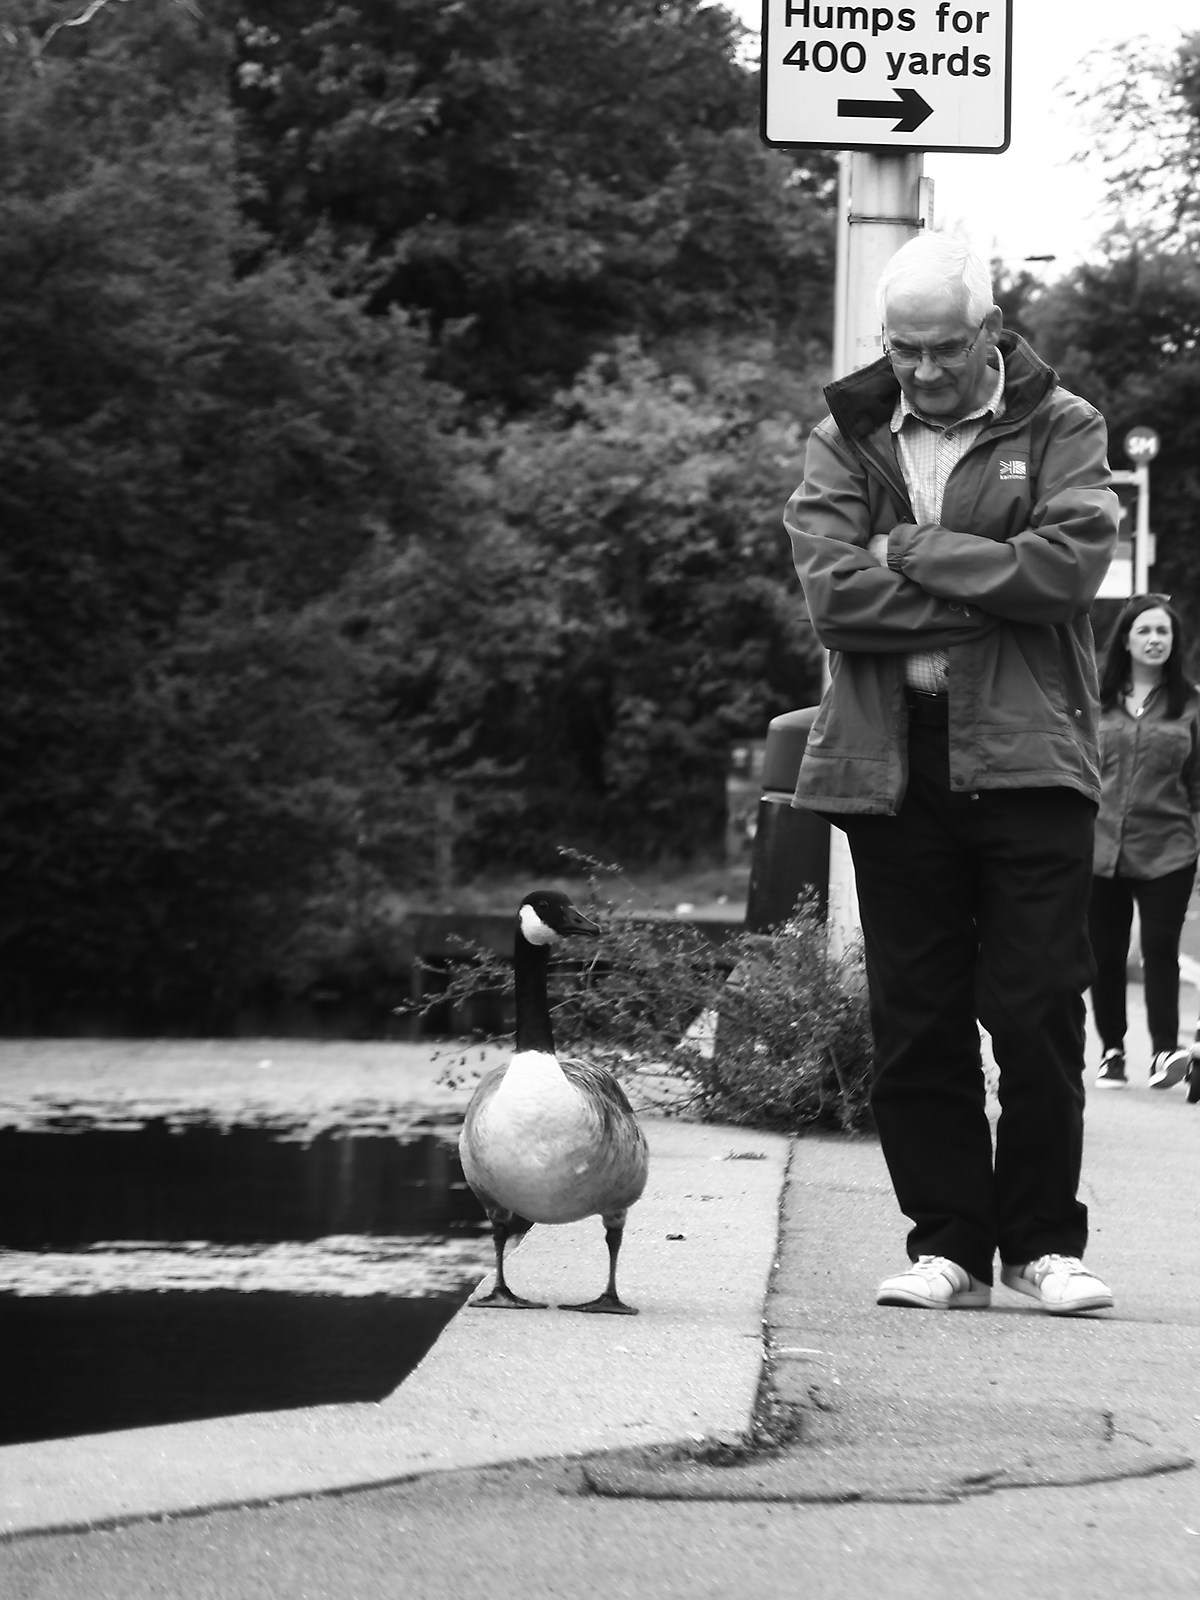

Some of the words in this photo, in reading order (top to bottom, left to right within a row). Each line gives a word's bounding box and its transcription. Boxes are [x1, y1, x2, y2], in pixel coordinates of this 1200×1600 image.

[785, 0, 916, 37] Humps
[935, 2, 990, 34] for
[782, 40, 867, 74] 400
[886, 46, 992, 81] yards
